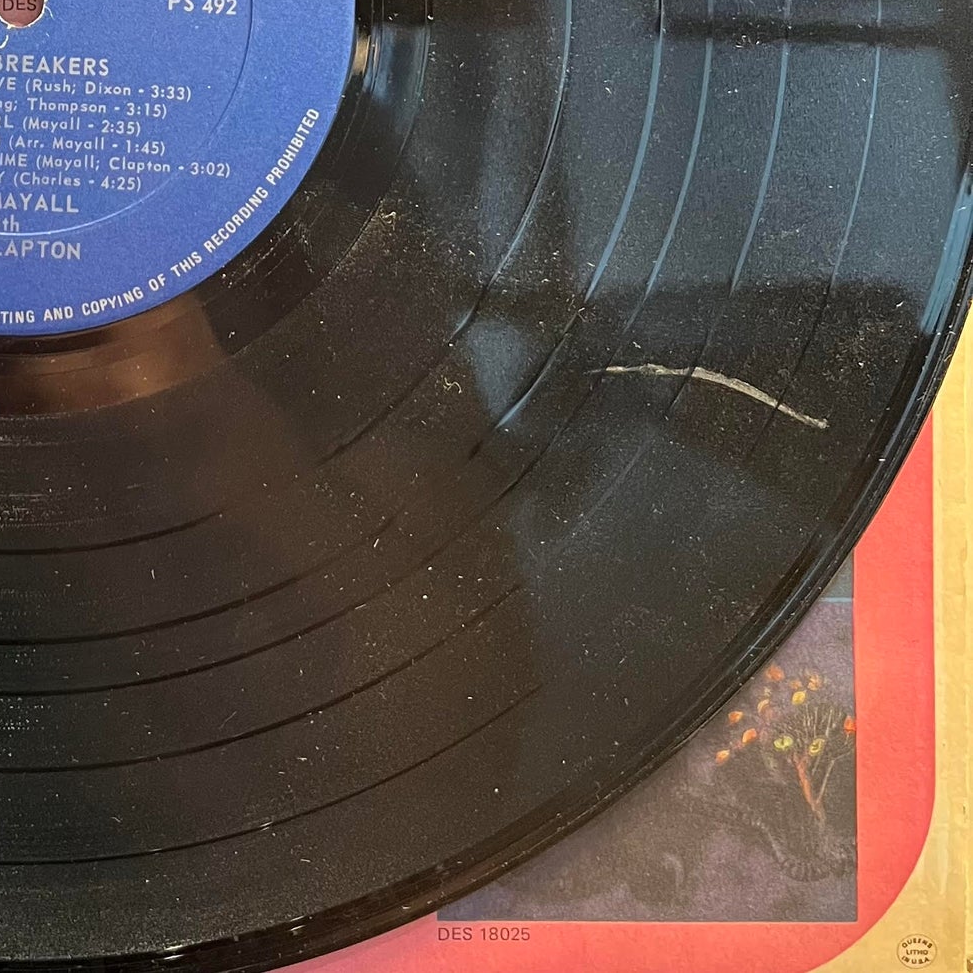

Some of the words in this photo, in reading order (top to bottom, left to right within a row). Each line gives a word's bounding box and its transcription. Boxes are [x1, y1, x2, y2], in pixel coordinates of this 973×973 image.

[25, 79, 76, 95] (Rush;
[85, 81, 131, 96] Dixon
[150, 85, 192, 102] 3:33)
[27, 98, 107, 114] Thompson
[126, 103, 167, 118] 3:15)
[22, 117, 80, 132] (Mayall
[101, 120, 142, 136] 2:35)
[8, 134, 45, 150] (Arr.
[52, 136, 105, 152] Mayall
[126, 140, 166, 156] 1:45)
[36, 155, 100, 171] (Mayall;
[109, 157, 171, 173] Clapton
[190, 162, 231, 178] 3:02)
[13, 172, 81, 187] (Charles
[101, 175, 142, 192] 4:25)
[43, 306, 74, 322] AND
[81, 287, 144, 317] COPYING
[148, 273, 167, 292] OF
[170, 251, 203, 278] THIS
[203, 186, 269, 254] RECORDING
[265, 108, 320, 186] PROHIBITED
[438, 927, 473, 941] DES
[480, 926, 531, 941] 18025
